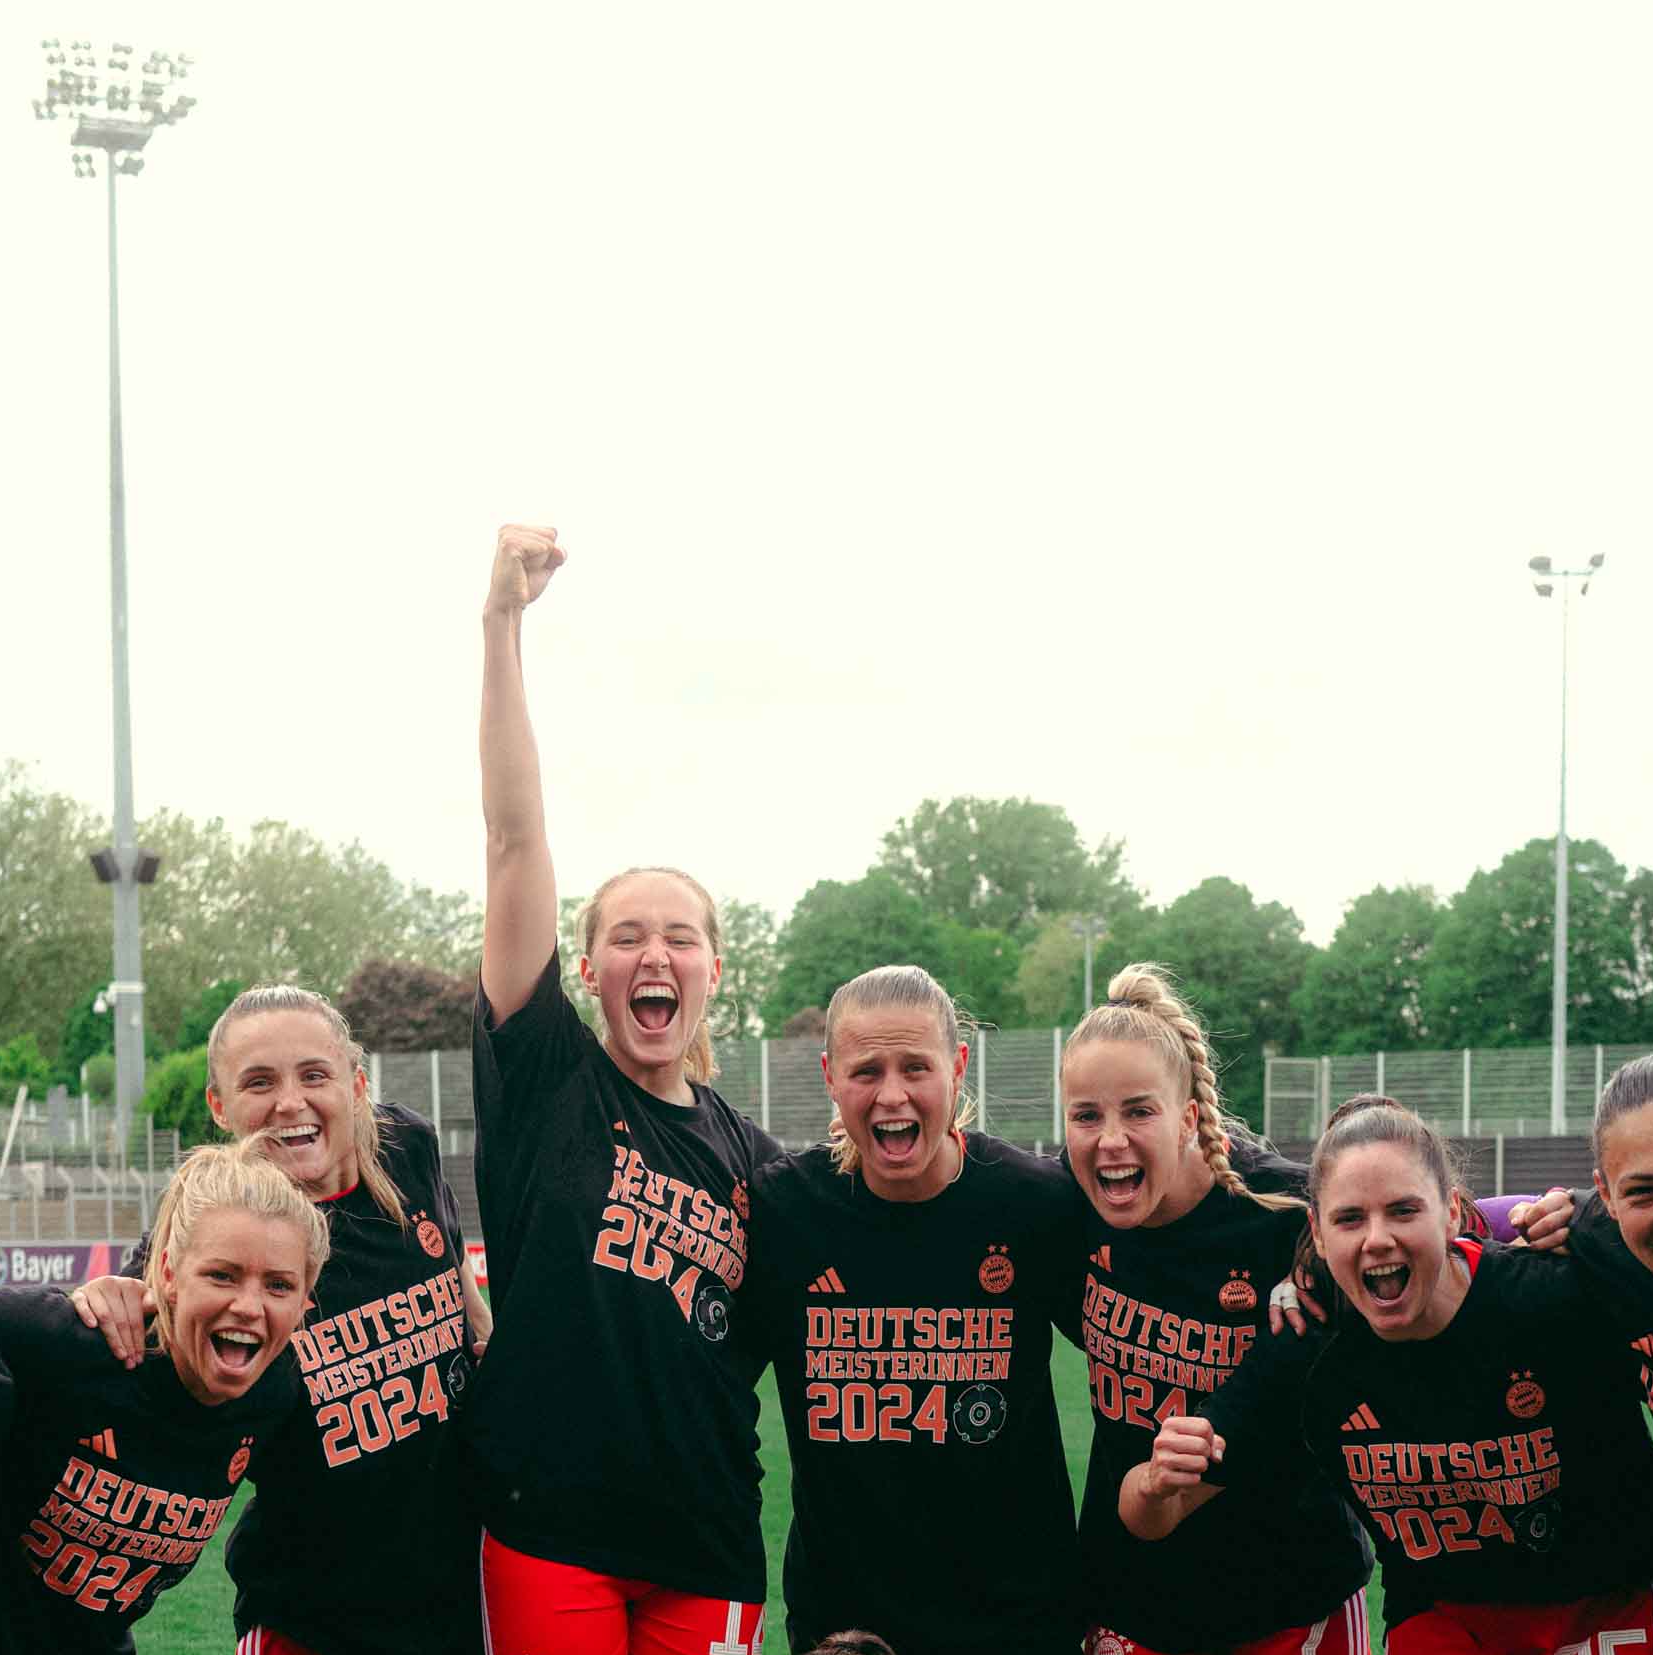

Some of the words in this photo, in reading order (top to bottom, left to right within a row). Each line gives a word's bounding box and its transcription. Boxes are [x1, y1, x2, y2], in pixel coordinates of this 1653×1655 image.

[11, 1249, 75, 1284] Bayer
[290, 1267, 465, 1374] DEUTSCHE
[805, 1307, 1013, 1350] DEUTSCHE
[303, 1314, 464, 1406] MEISTERINNE
[805, 1350, 1012, 1382] MEISTERINNEN
[316, 1362, 449, 1468] 2024
[806, 1382, 948, 1445] 2024
[1342, 1427, 1560, 1484] DEUTSCHE
